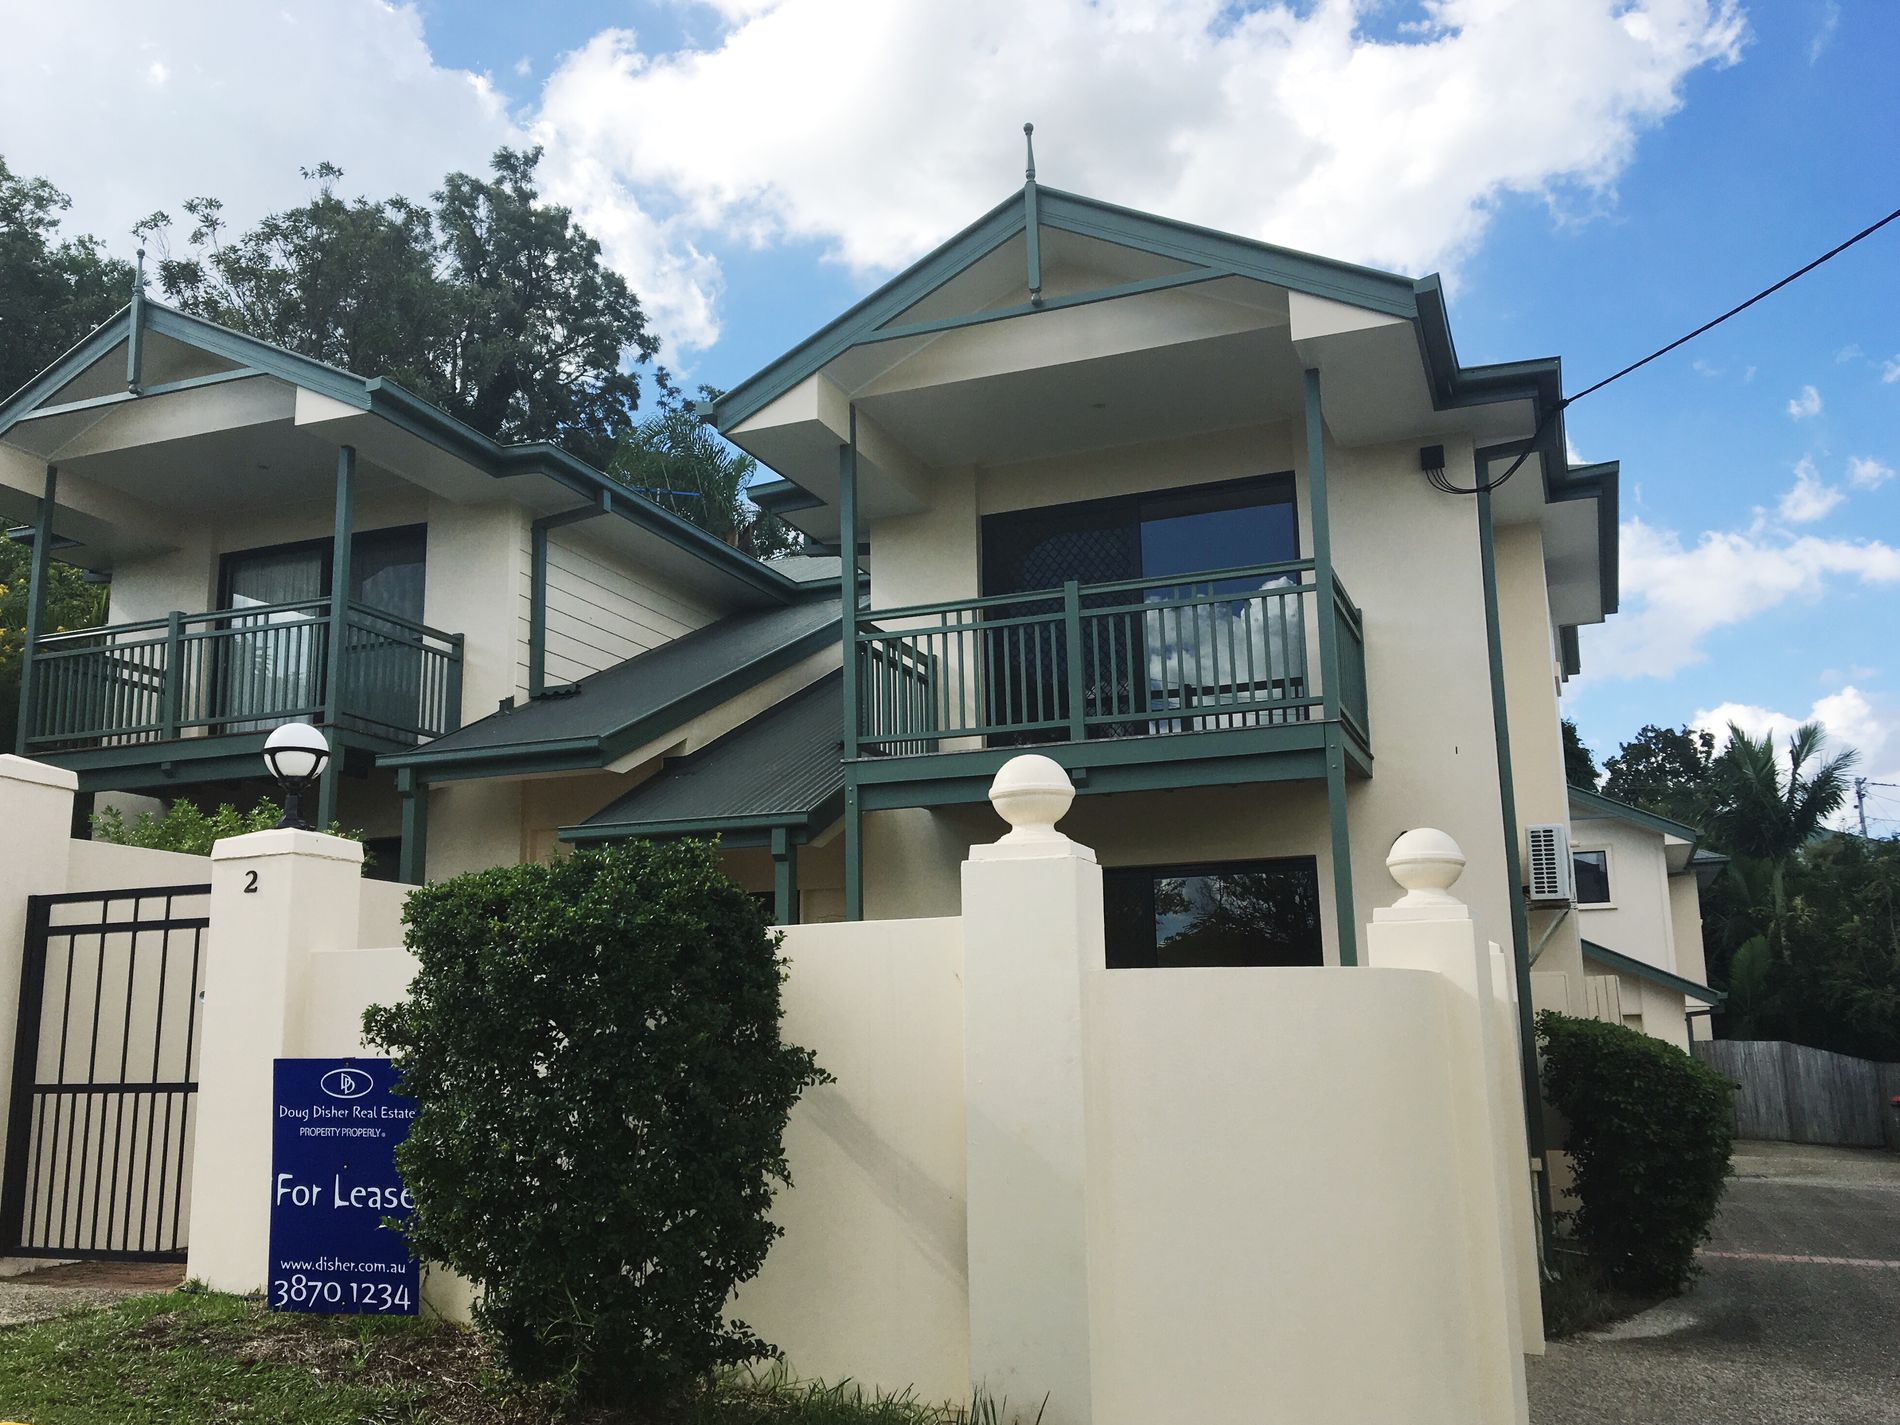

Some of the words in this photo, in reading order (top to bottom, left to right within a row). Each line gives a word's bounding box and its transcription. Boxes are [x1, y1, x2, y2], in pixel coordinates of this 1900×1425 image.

[243, 870, 258, 893] 2
[279, 1104, 309, 1122] Doug
[313, 1105, 349, 1119] Disher
[352, 1105, 378, 1119] Real
[380, 1106, 416, 1119] Estate
[299, 1127, 341, 1137] PROPERTY
[276, 1173, 322, 1207] For
[334, 1173, 415, 1210] Lease
[280, 1256, 406, 1274] www.disher.com.au
[274, 1274, 341, 1308] 3870
[350, 1282, 411, 1311] 1234
